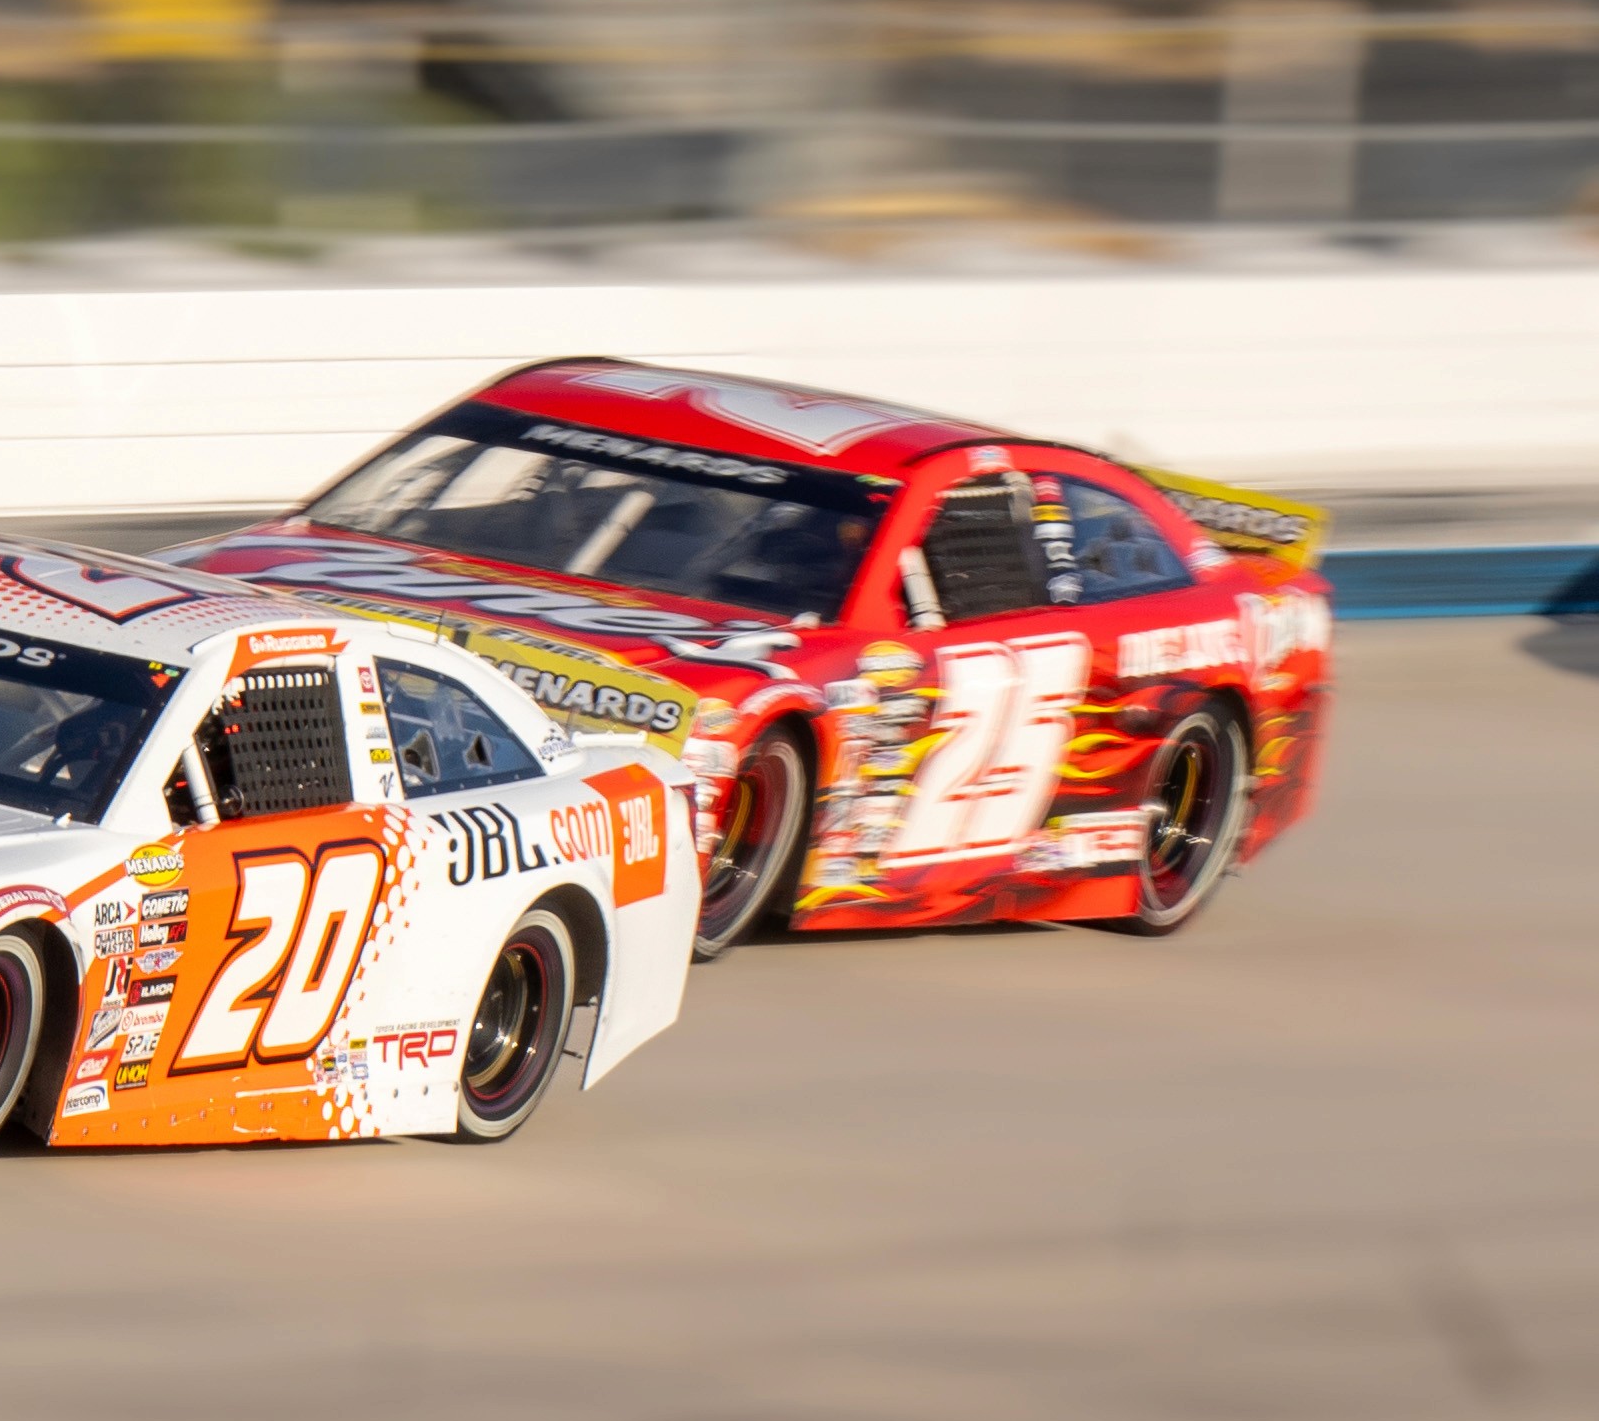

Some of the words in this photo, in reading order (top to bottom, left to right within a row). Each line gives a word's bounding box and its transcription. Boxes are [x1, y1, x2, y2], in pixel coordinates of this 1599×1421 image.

[520, 424, 794, 485] MENARDS
[619, 795, 659, 865] JBL
[430, 800, 611, 886] JBL.com
[123, 854, 185, 877] MENARDS
[95, 902, 121, 926] ARCA
[142, 894, 189, 917] COMETIC
[95, 930, 133, 949] QUARTER
[100, 942, 134, 957] MASTER
[168, 838, 389, 1077] 20
[133, 1012, 164, 1027] brembo
[375, 1025, 395, 1033] TOYOTA
[396, 1023, 417, 1031] RACING
[419, 1019, 461, 1029] DEVELOPMENT
[373, 1029, 458, 1071] TRD
[115, 1064, 150, 1084] UNOH
